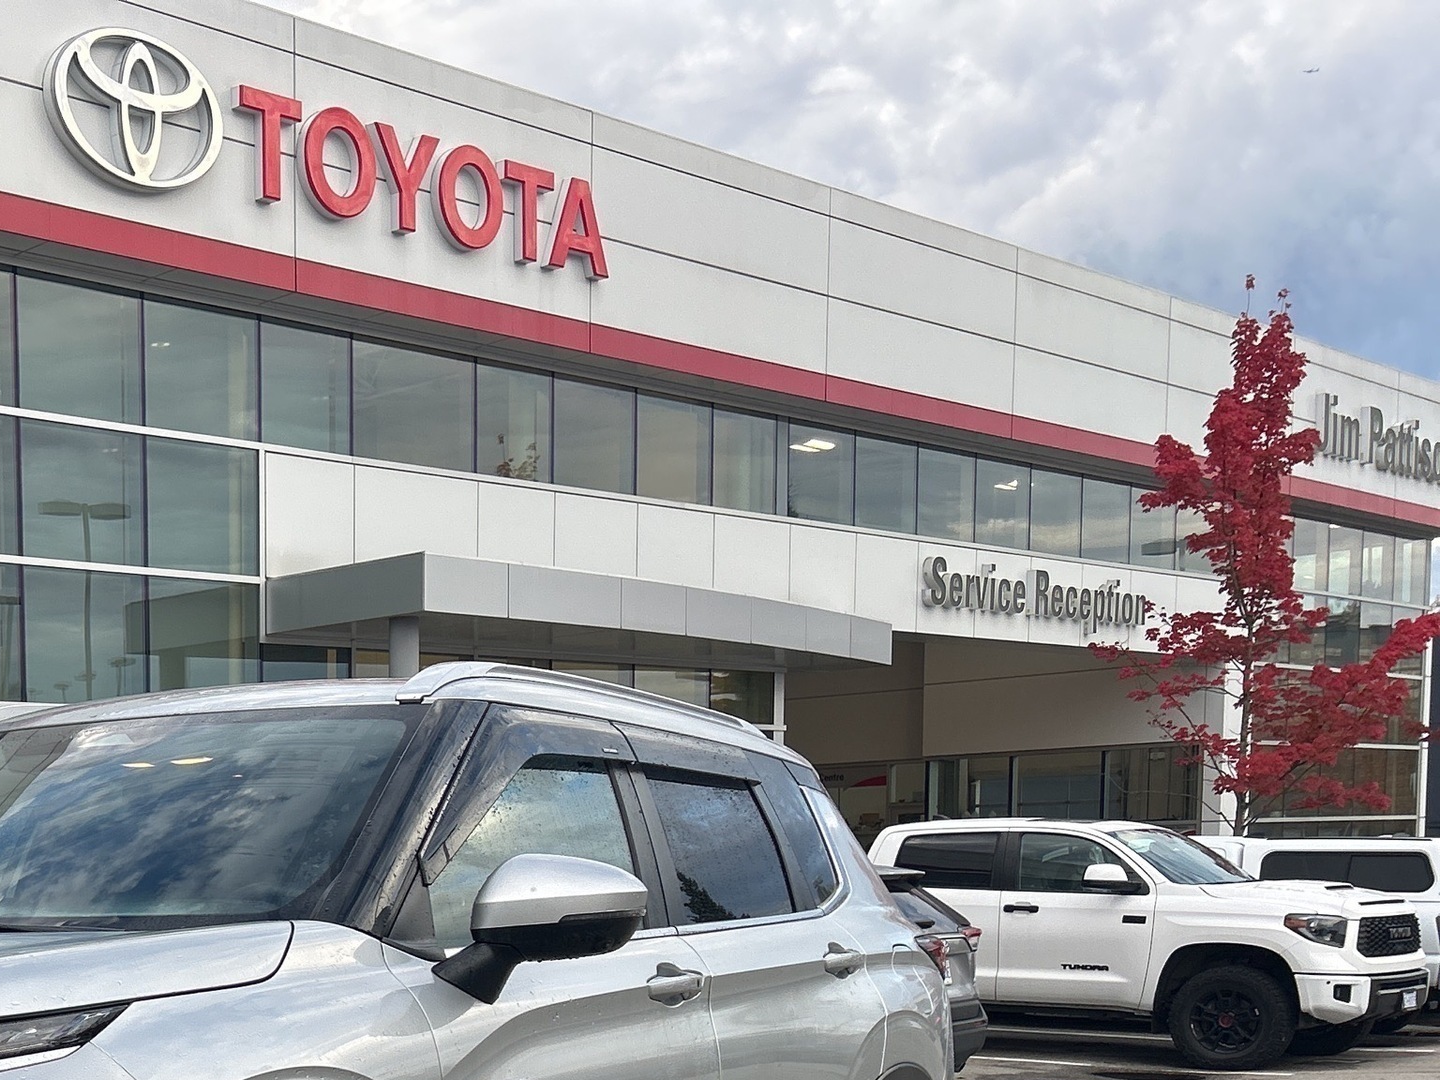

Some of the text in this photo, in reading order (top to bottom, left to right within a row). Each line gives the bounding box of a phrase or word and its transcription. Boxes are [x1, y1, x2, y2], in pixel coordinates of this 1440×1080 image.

[231, 84, 609, 281] TOYOTA
[1317, 392, 1360, 461] Jim
[923, 556, 1148, 634] Service Reception
[1060, 963, 1110, 972] TUNDRA
